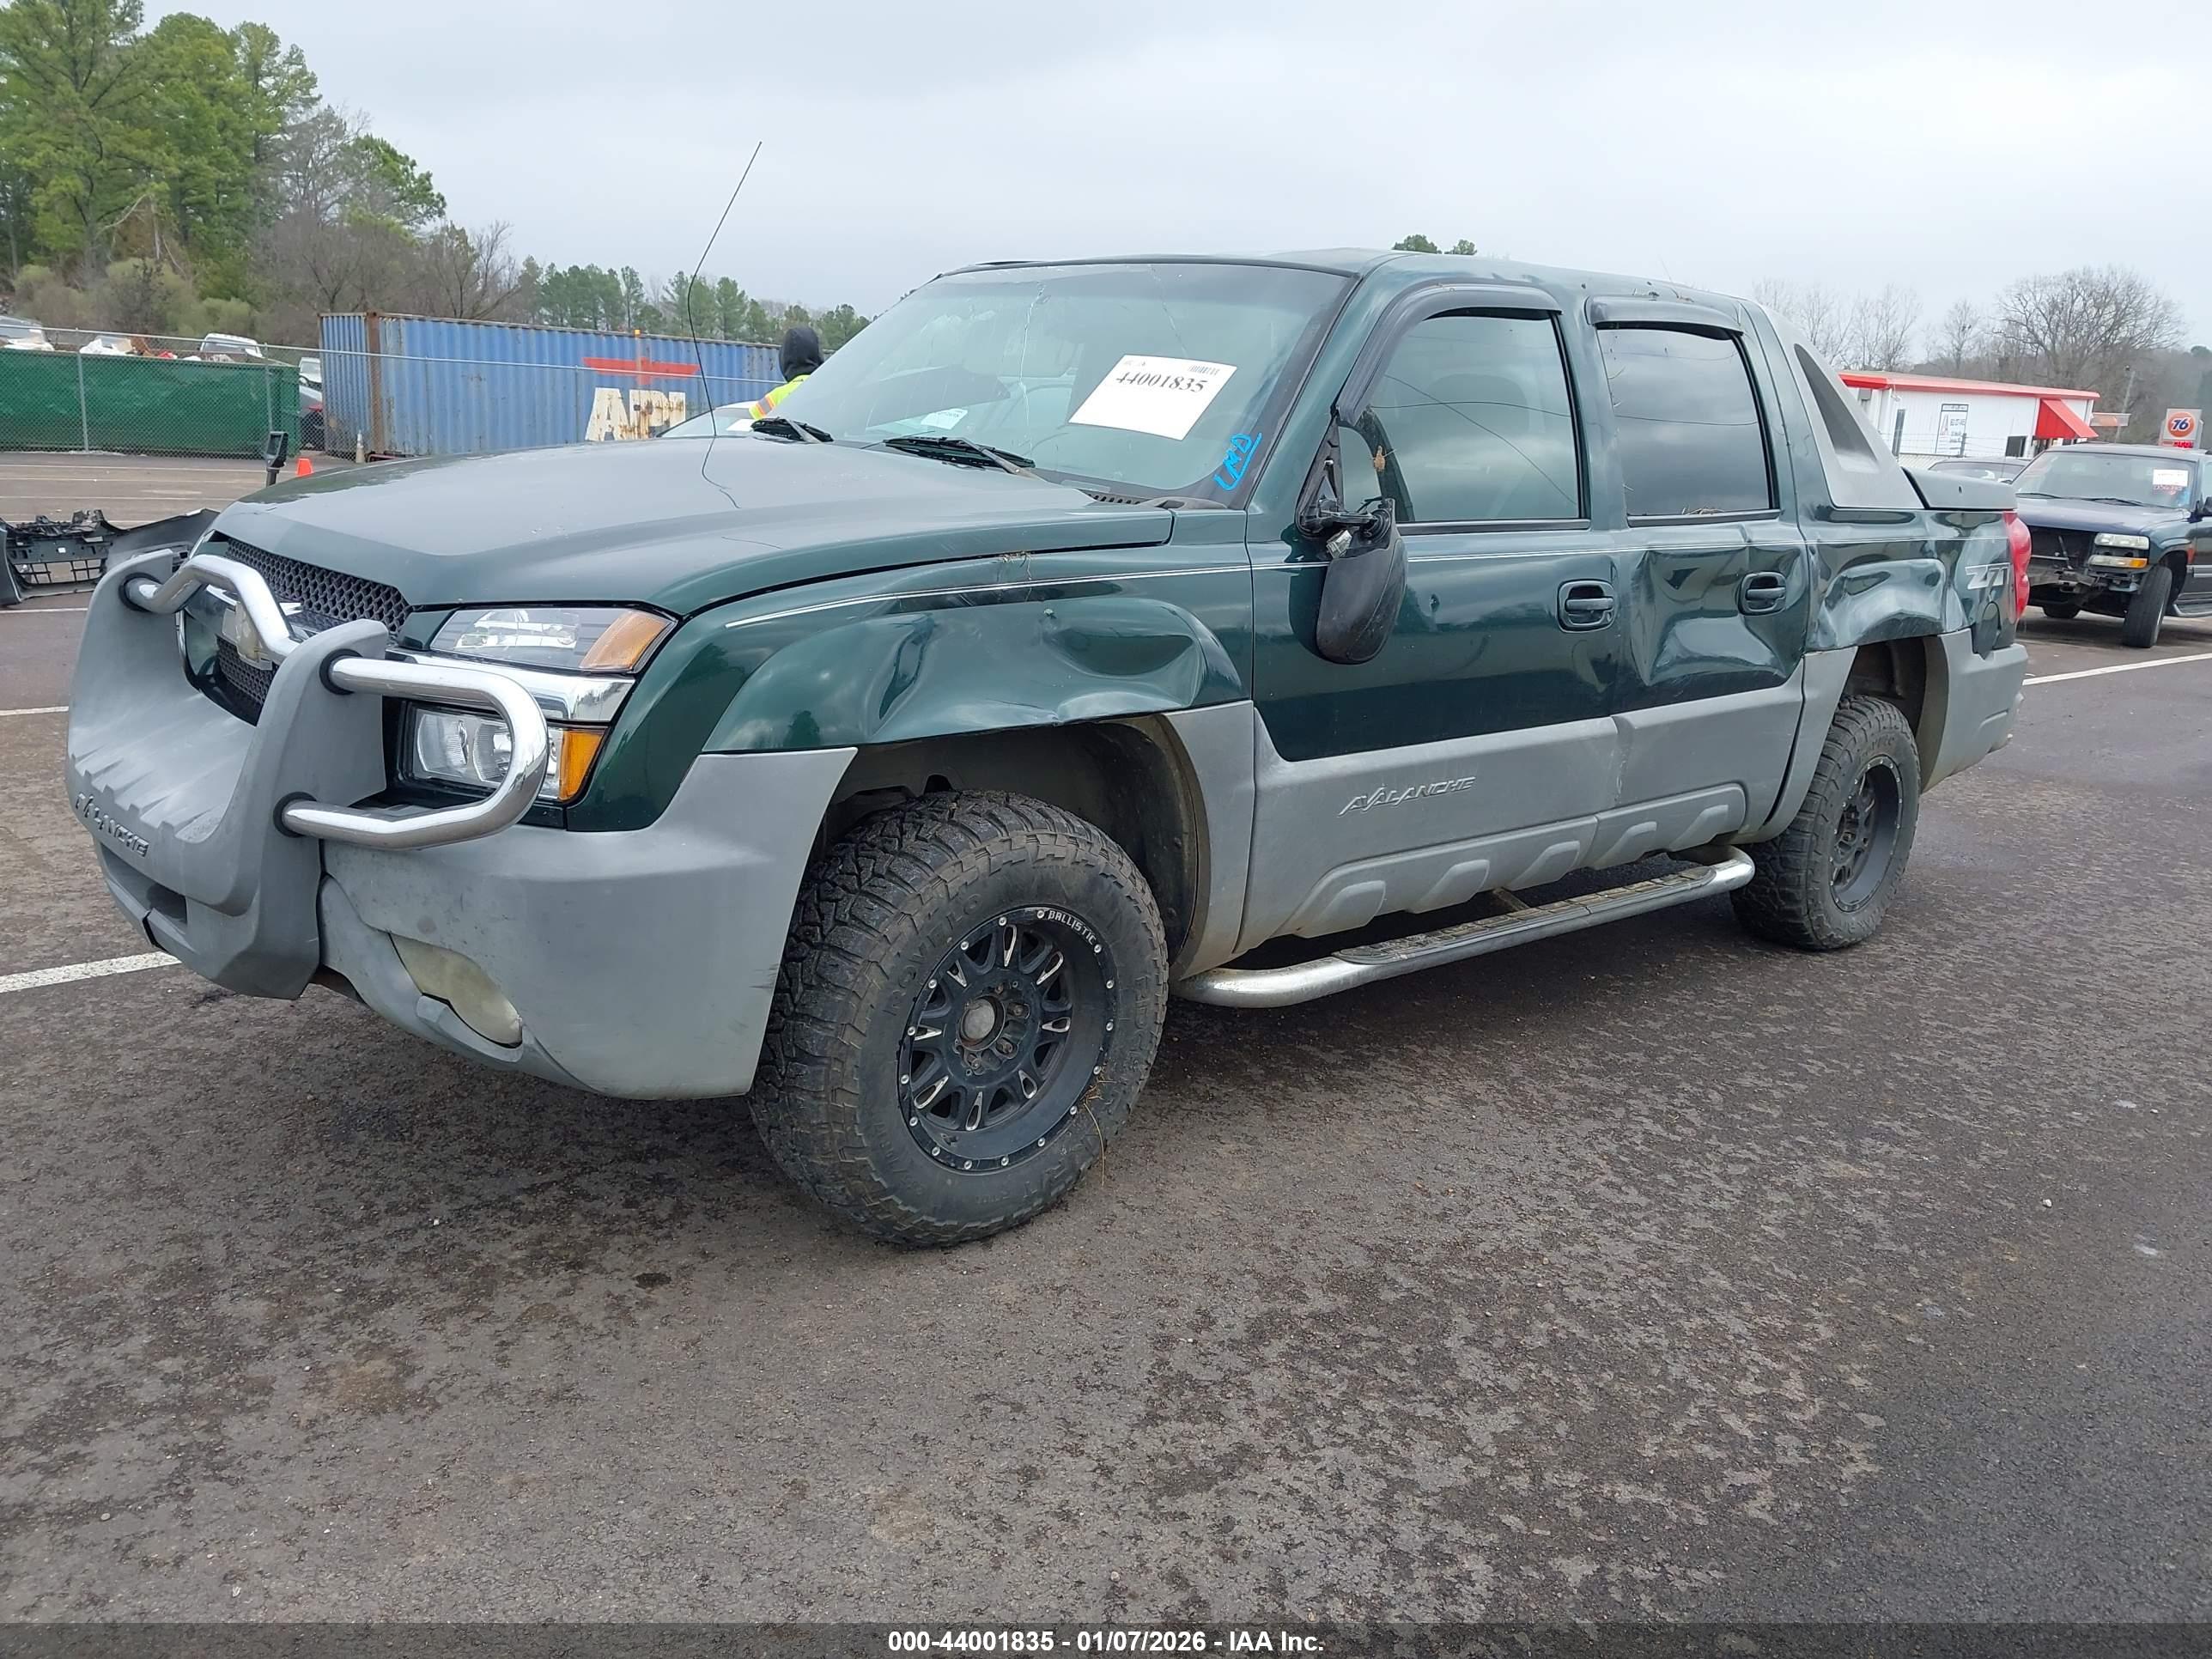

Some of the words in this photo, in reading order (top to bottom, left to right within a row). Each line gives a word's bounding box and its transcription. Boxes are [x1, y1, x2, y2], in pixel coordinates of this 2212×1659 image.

[1115, 371, 1208, 392] 44001835
[2172, 416, 2191, 431] 76
[1337, 775, 1477, 817] AVALANCHE
[1048, 909, 1097, 945] BALLISTIC
